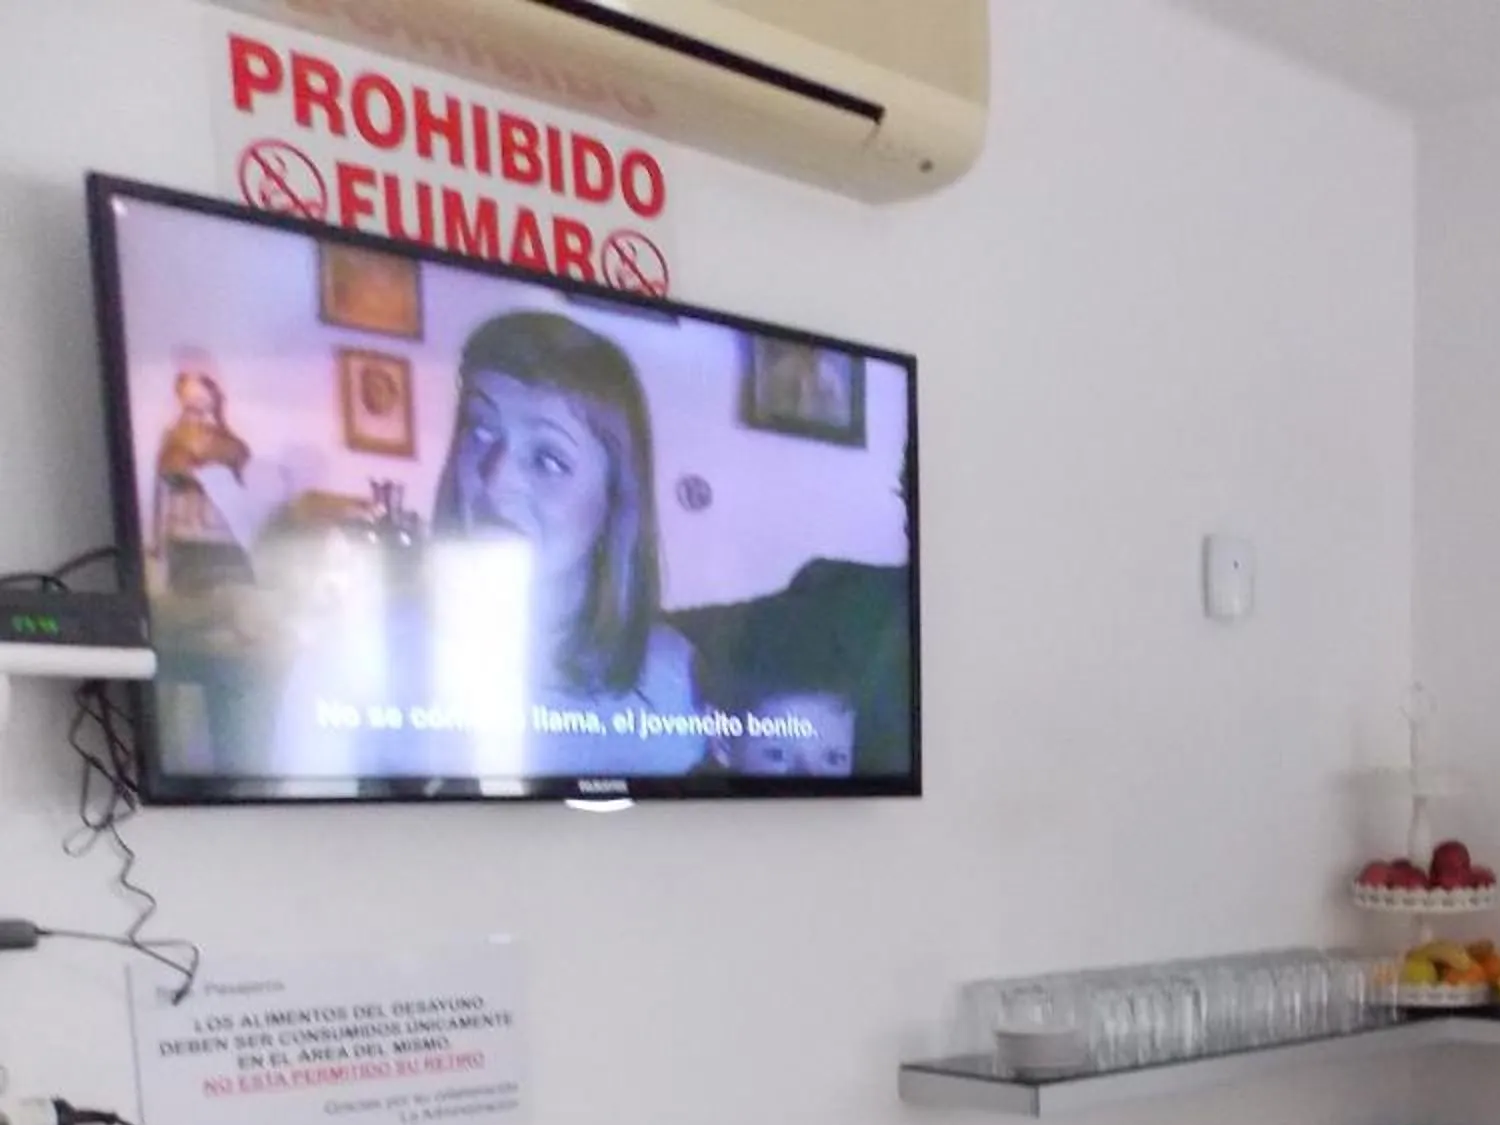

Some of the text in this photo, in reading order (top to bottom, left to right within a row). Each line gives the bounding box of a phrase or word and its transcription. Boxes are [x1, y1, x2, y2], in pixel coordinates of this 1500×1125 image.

[228, 33, 666, 220] PROHIBIDO
[334, 160, 598, 285] FUMAR
[316, 699, 360, 729] No
[532, 705, 607, 736] llama,
[613, 708, 635, 733] el
[640, 708, 743, 739] jovencito
[748, 711, 819, 738] bonito.
[194, 995, 485, 1034] LOS ALIMENTOS DEL DESAYUNO
[159, 1036, 228, 1057] DEBEN
[234, 1033, 274, 1051] SER
[279, 1022, 401, 1047] CONSUMIDOS
[238, 1054, 264, 1070] EN
[269, 1052, 290, 1067] EL
[353, 1042, 386, 1059] DEL
[393, 1036, 450, 1054] MISMO
[203, 1077, 233, 1096] NO
[291, 1060, 391, 1087] PERMITIDO
[424, 1051, 485, 1071] RETIRO
